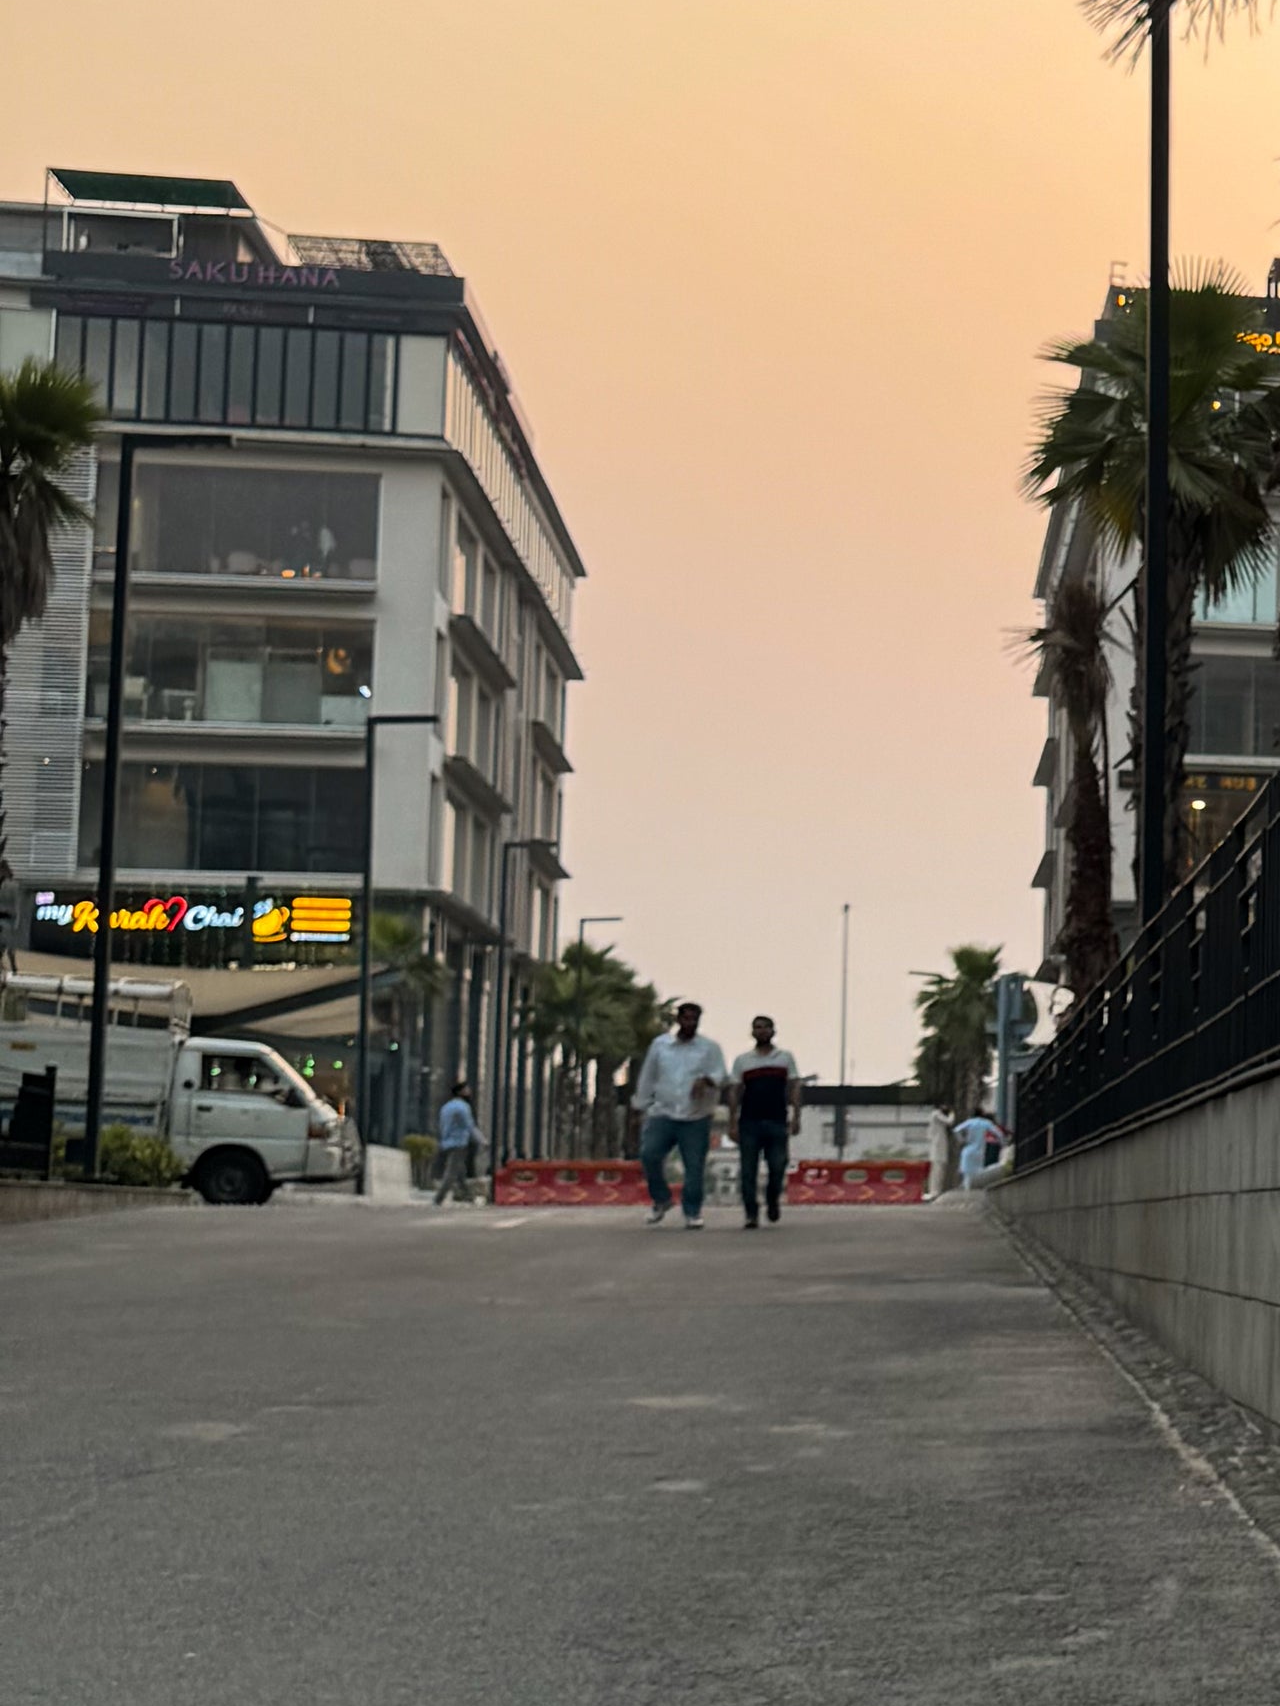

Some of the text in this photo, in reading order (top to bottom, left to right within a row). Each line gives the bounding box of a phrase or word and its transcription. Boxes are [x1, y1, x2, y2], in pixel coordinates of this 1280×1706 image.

[168, 260, 341, 288] SAKU HANA
[36, 904, 74, 926] my
[182, 904, 245, 932] Chai
